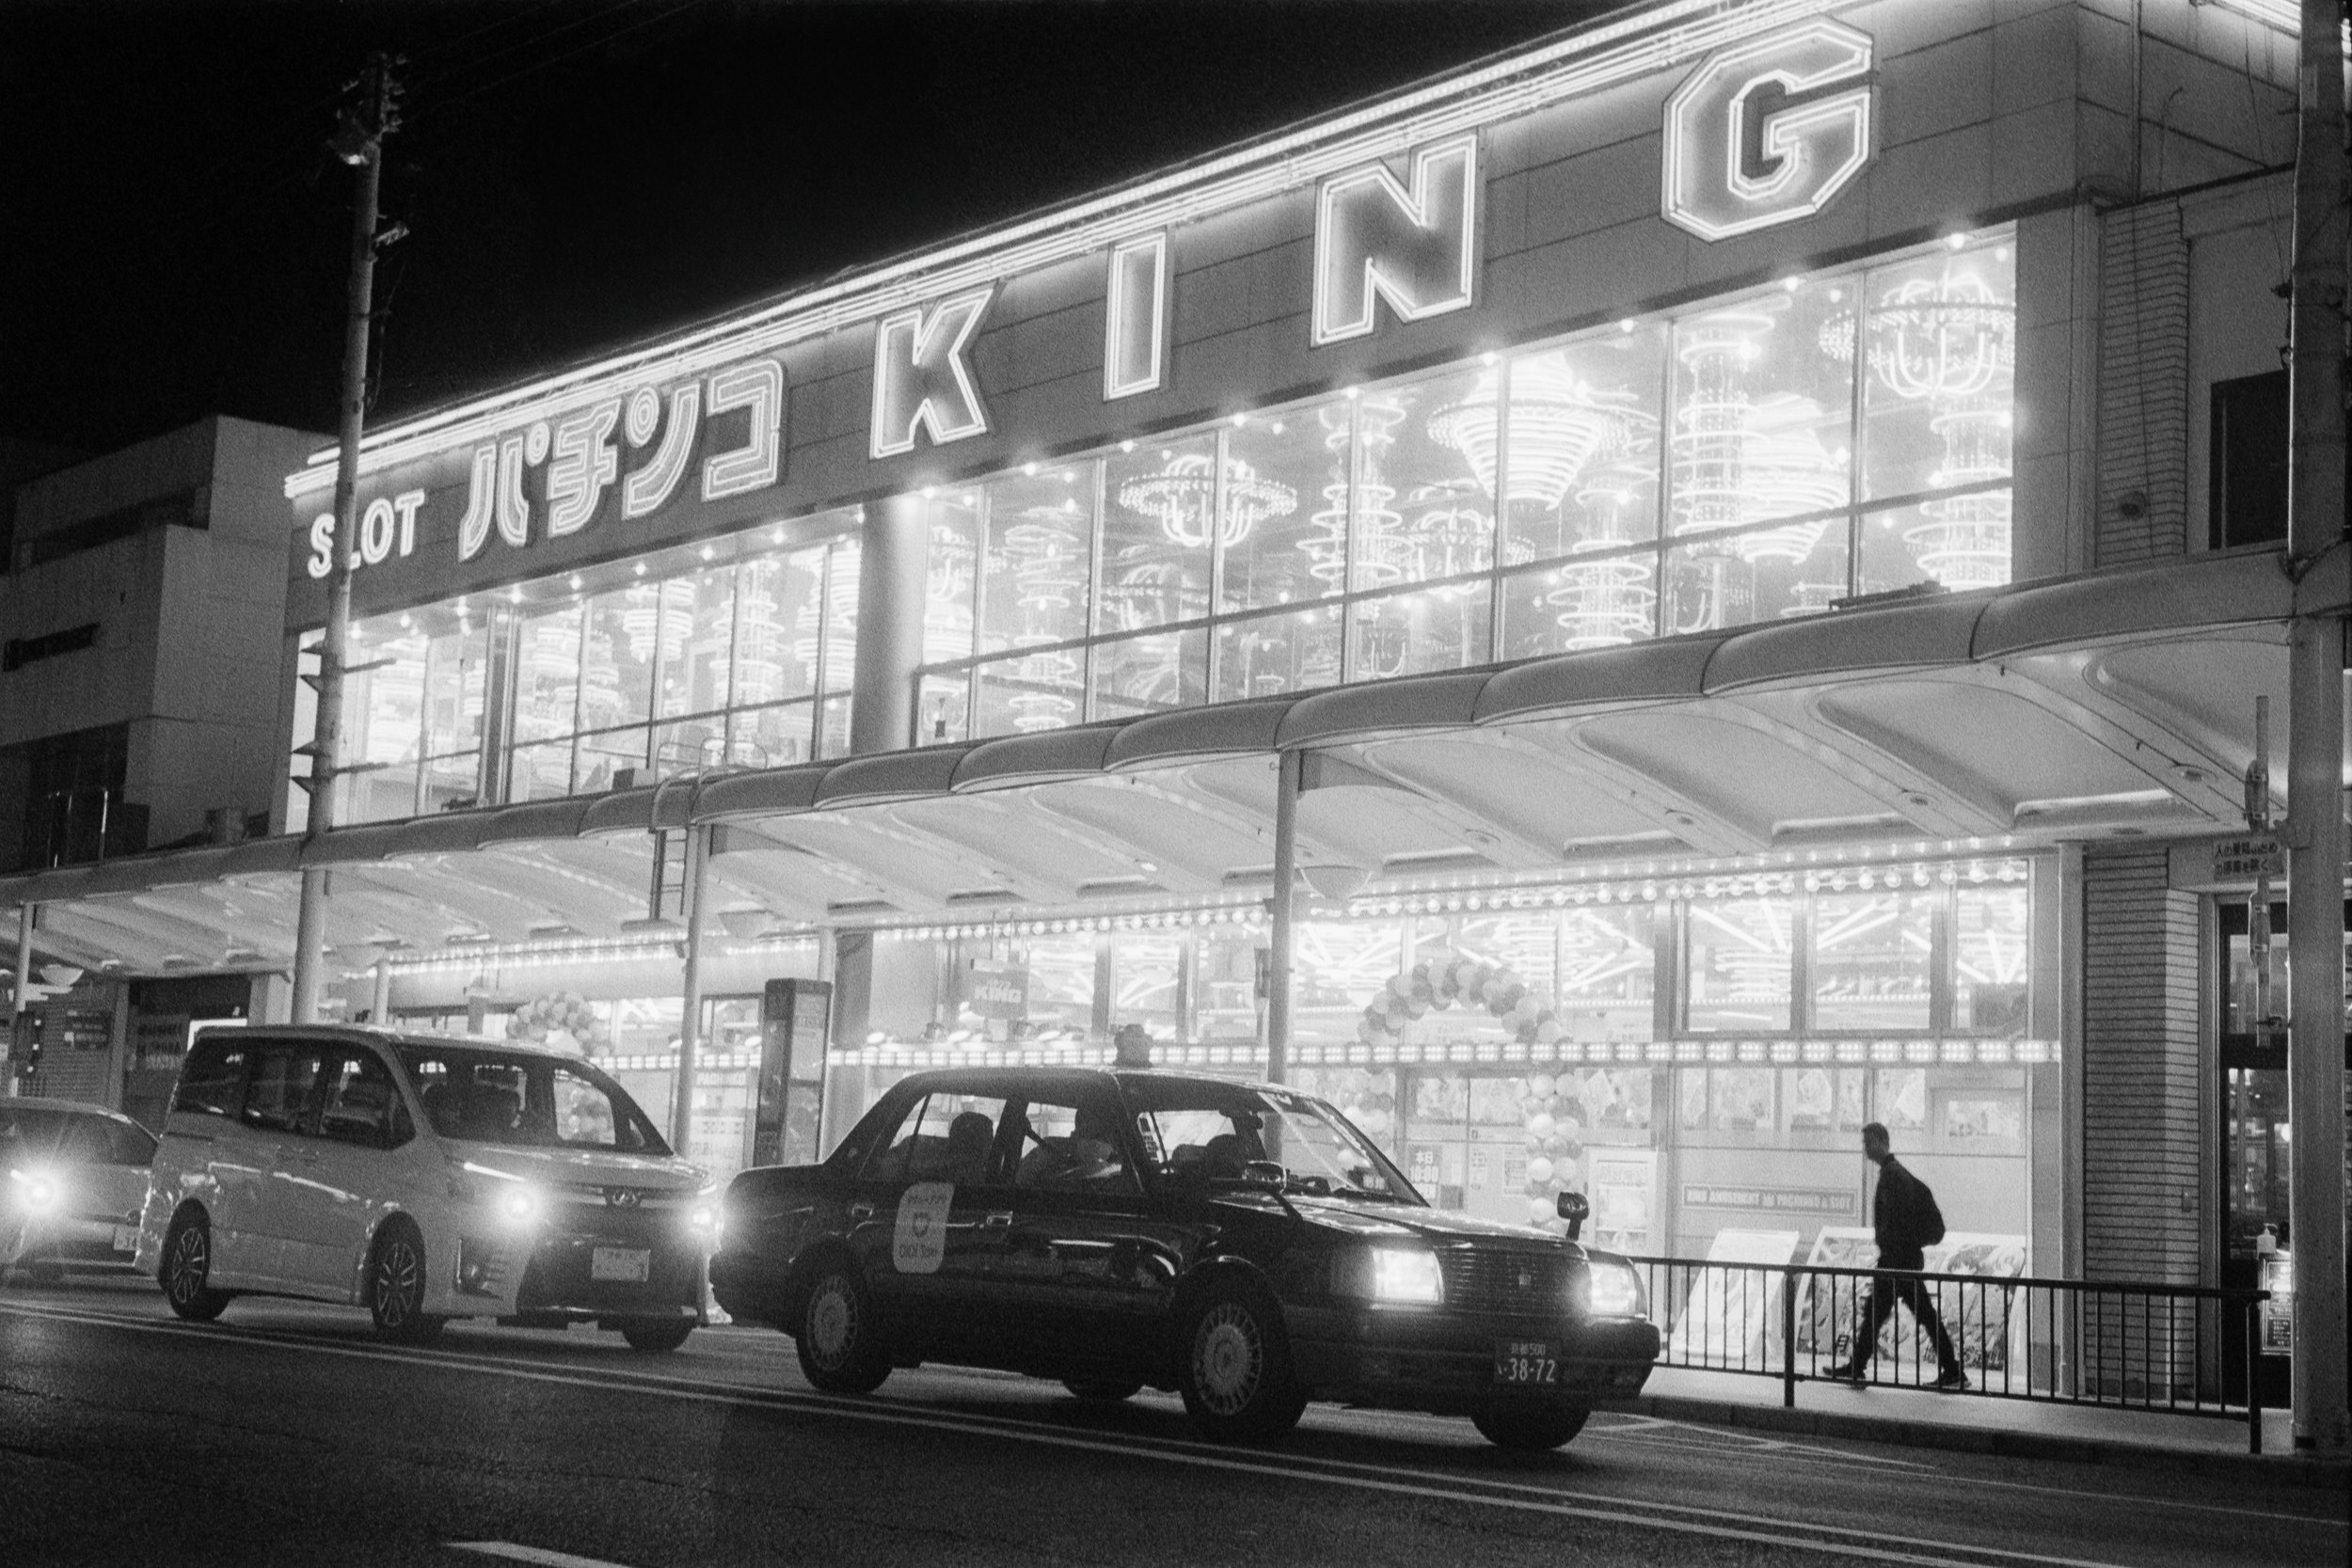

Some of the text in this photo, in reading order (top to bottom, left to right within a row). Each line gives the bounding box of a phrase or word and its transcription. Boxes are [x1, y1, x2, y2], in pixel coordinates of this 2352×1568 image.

[870, 13, 1875, 460] KING
[457, 358, 785, 562] パチンコ
[974, 985, 1022, 1004] KING
[1508, 1357, 1556, 1383] 38-72
